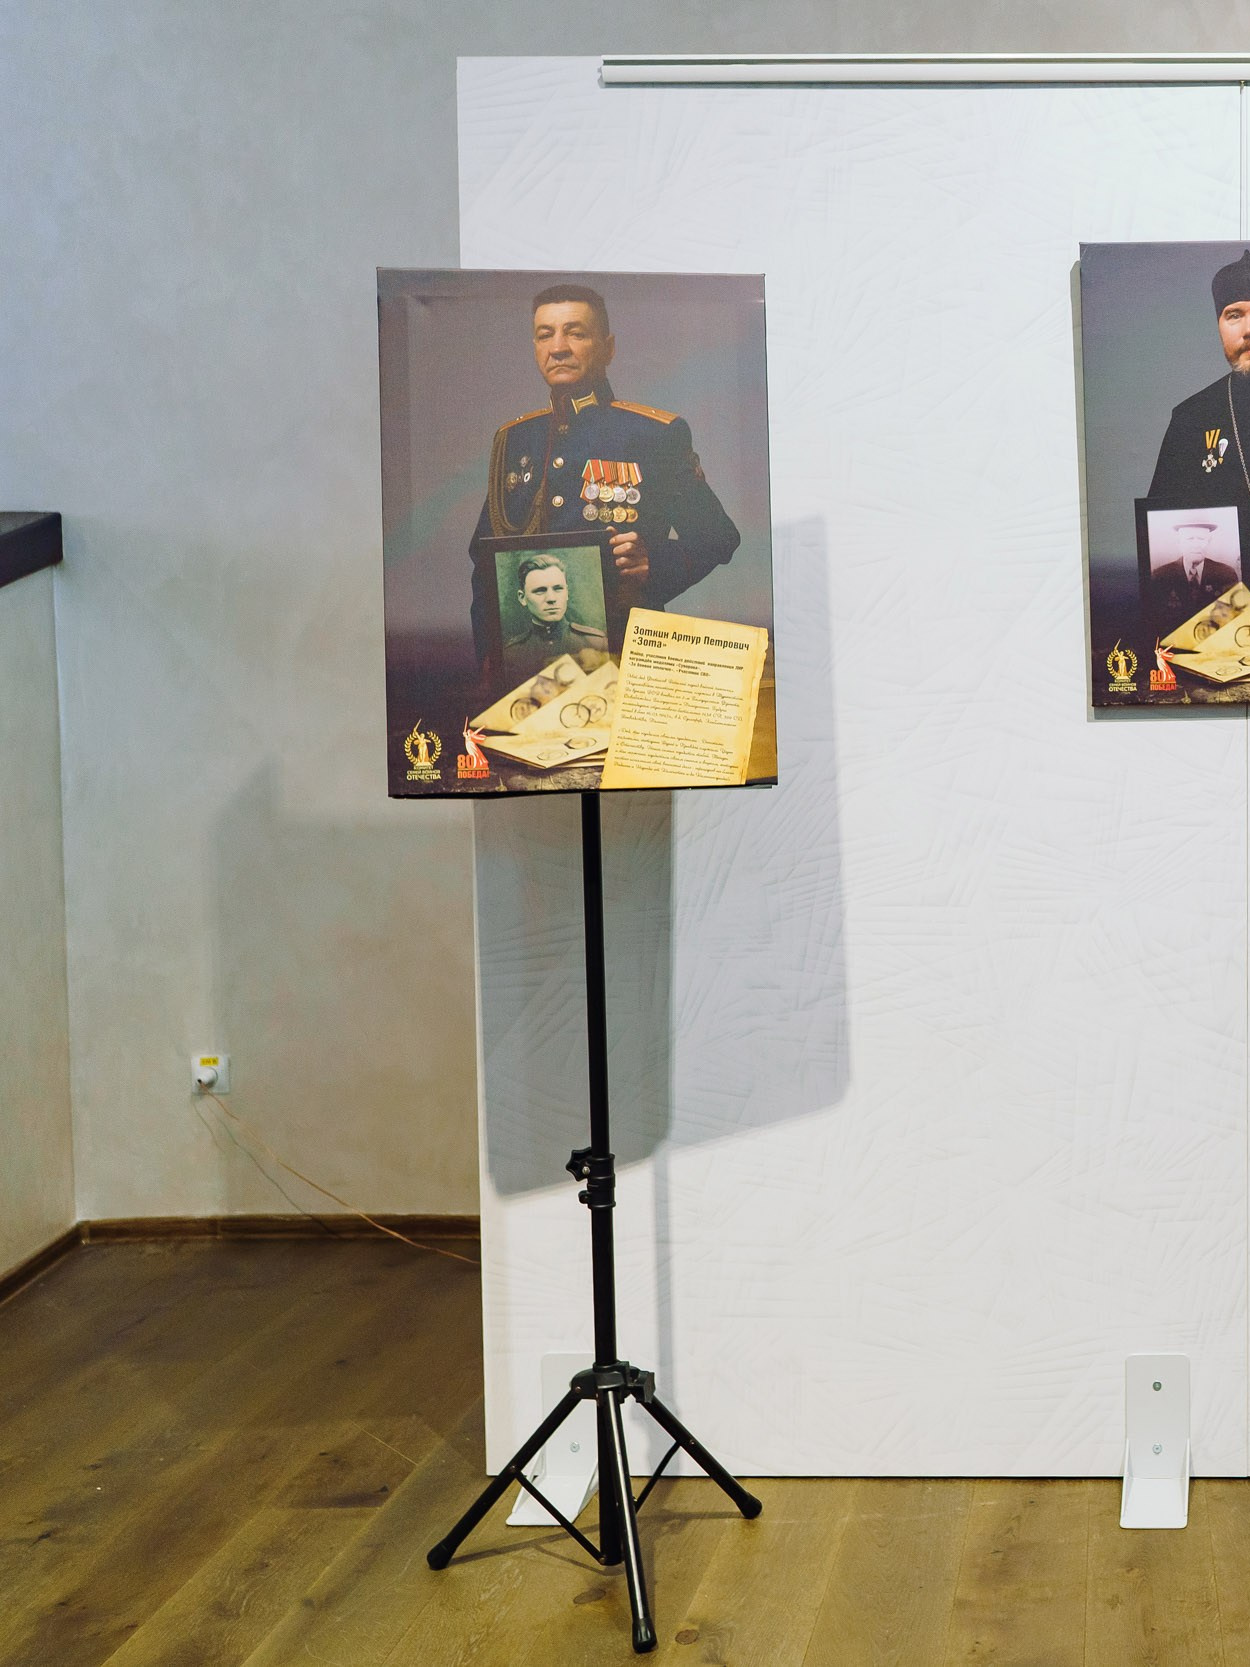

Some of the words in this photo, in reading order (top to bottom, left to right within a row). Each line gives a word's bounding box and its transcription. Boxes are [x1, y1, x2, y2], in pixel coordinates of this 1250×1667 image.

[632, 636, 667, 649] «Зота»
[633, 625, 669, 639] Зоткин
[671, 631, 701, 645] Артур
[703, 636, 750, 651] Петрович
[1150, 670, 1164, 682] 80
[457, 754, 475, 768] 80
[457, 771, 490, 779] ПОБЕДА!
